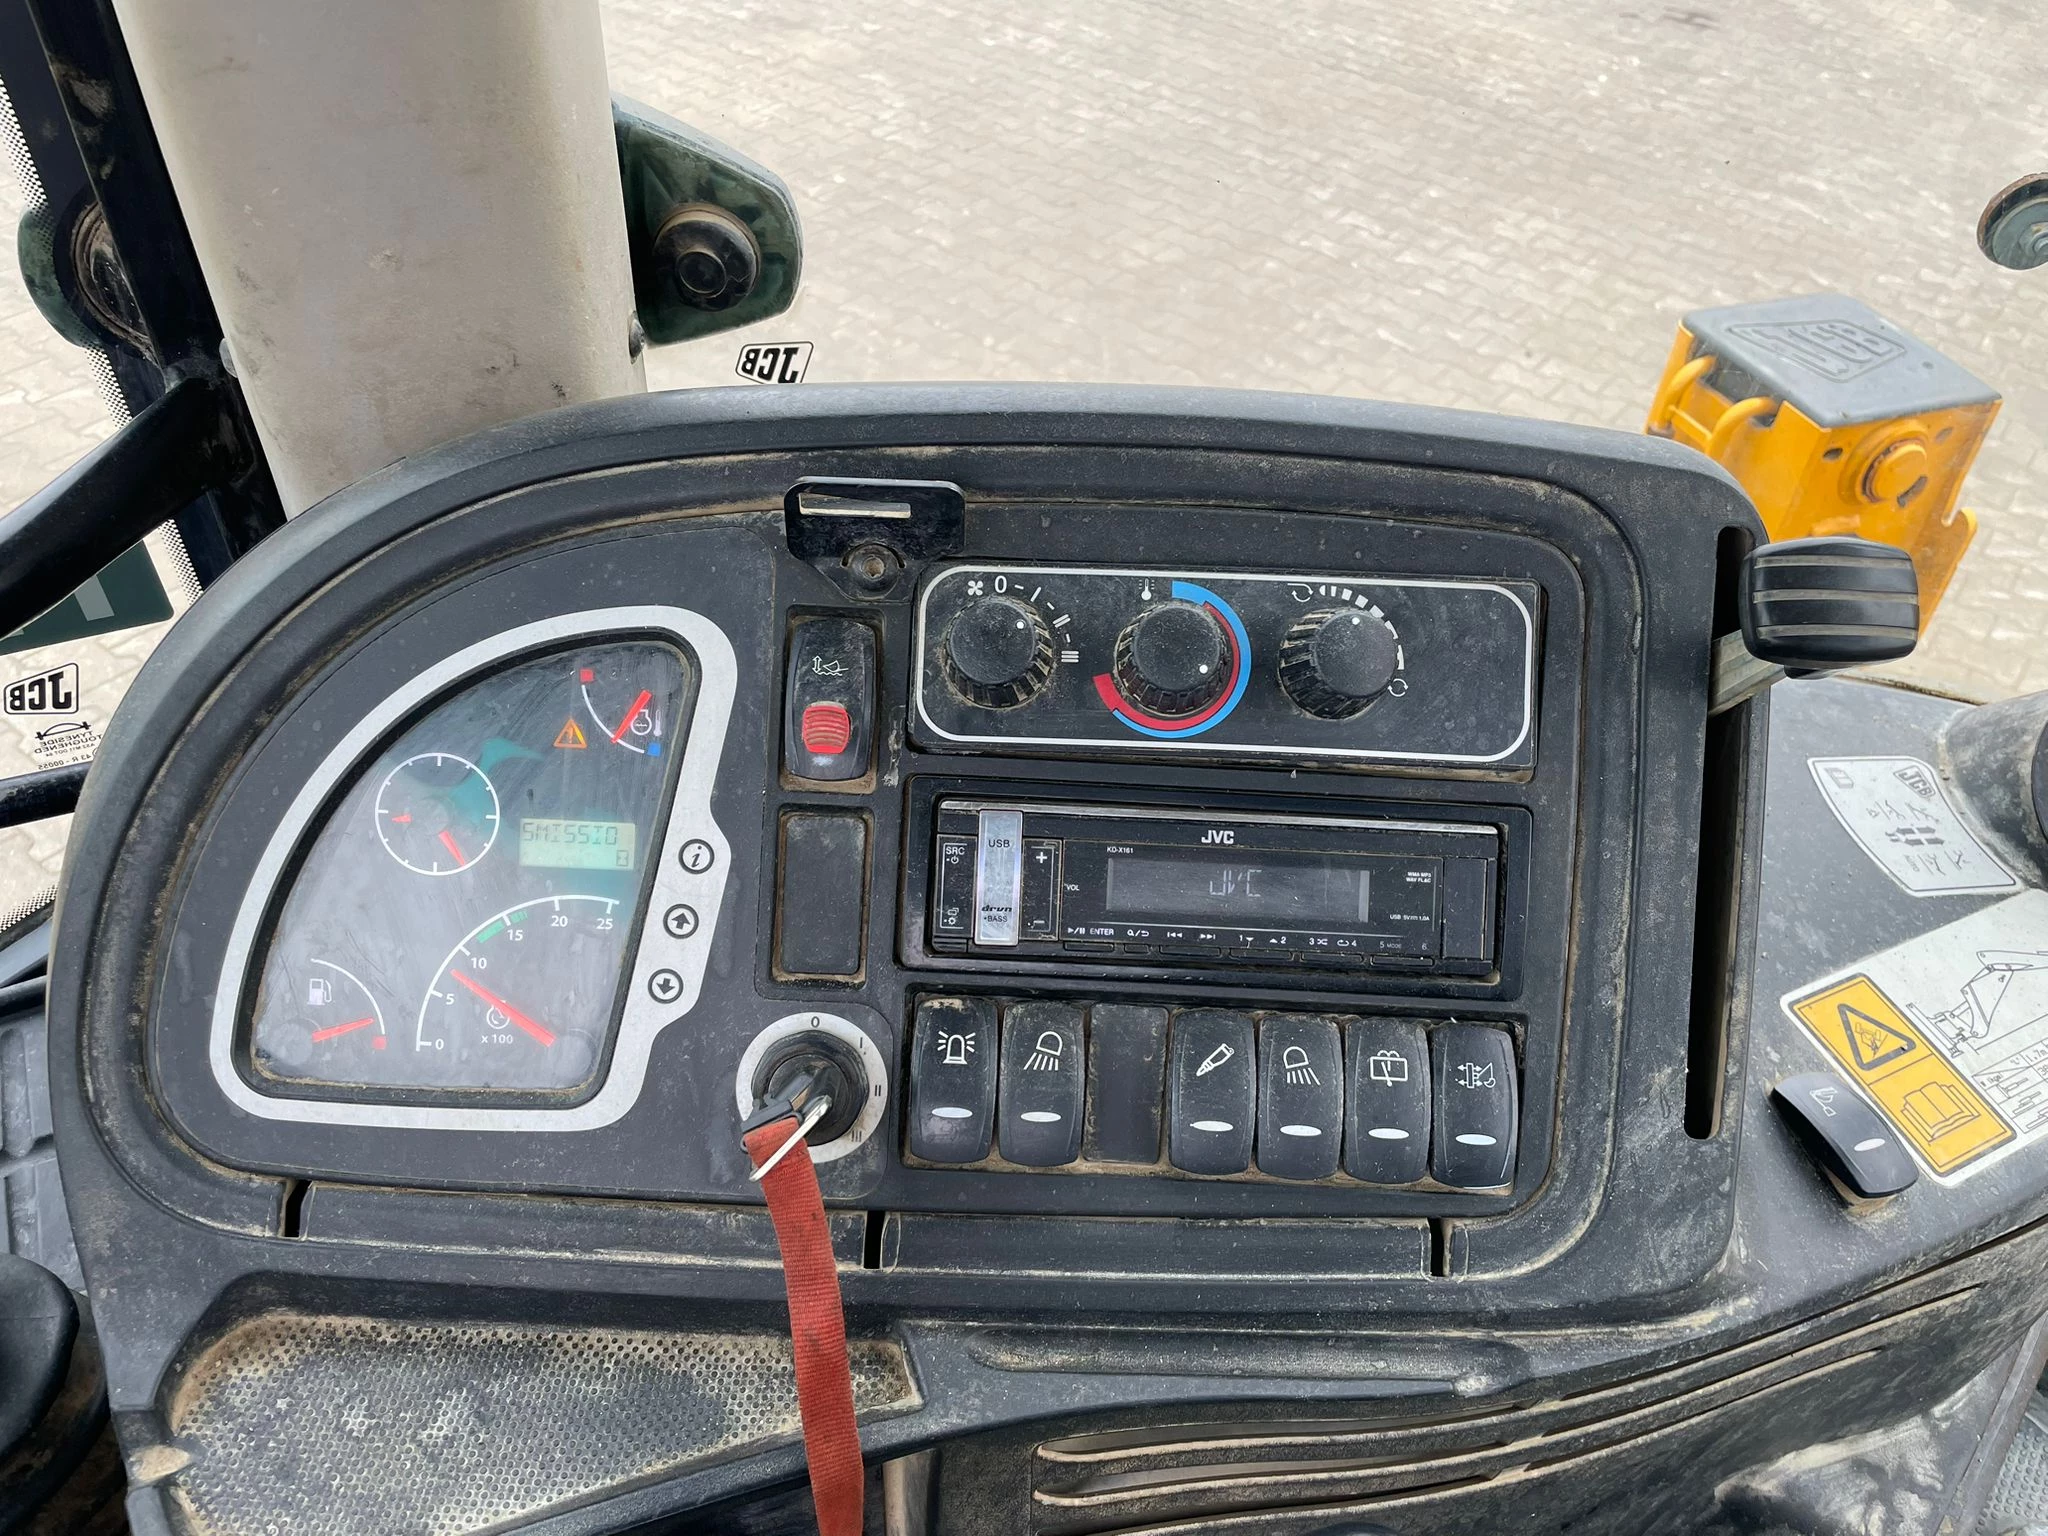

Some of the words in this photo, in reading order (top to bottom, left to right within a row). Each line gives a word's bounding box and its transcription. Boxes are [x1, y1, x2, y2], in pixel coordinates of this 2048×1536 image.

[1899, 767, 1935, 797] JCB
[1201, 830, 1235, 845] JVC
[988, 839, 1011, 848] USB
[945, 847, 965, 855] SRC
[1106, 846, 1134, 854] KD-X161
[1209, 869, 1262, 897] JVC
[551, 915, 568, 927] 20
[596, 918, 613, 930] 25
[507, 929, 523, 941] 15
[1089, 928, 1114, 936] ENTER
[1281, 936, 1287, 944] 2
[1351, 939, 1357, 947] 4
[1379, 941, 1385, 949] 5
[471, 957, 487, 969] 10
[446, 994, 455, 1005] 5
[811, 1016, 820, 1028] 0
[435, 1039, 444, 1050] 0
[480, 1035, 488, 1043] x
[492, 1034, 513, 1044] 100
